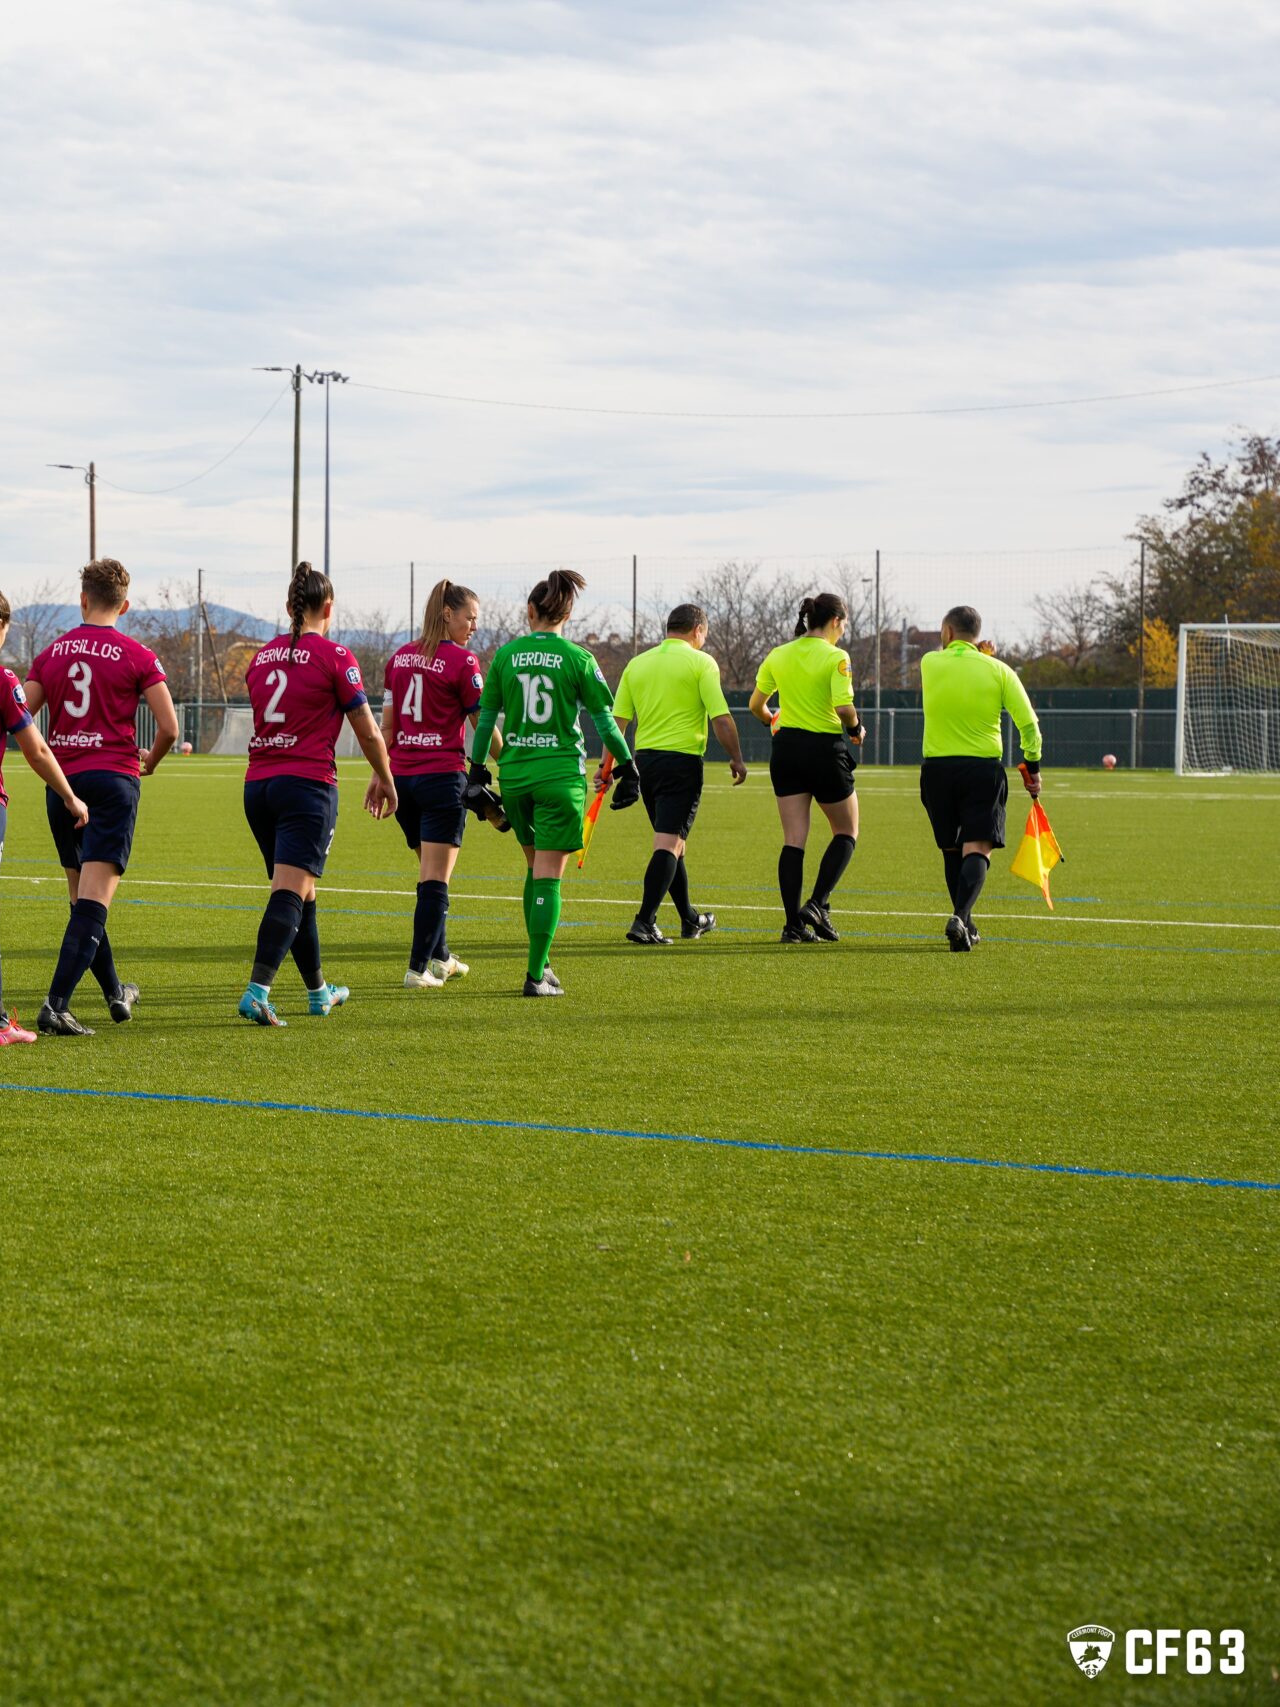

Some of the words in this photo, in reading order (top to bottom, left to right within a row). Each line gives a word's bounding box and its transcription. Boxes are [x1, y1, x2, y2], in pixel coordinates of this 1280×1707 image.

[51, 639, 122, 661] PITSILLOS
[255, 647, 310, 666] BERNARD
[511, 651, 563, 669] VERDIER
[64, 661, 92, 718] 3
[264, 669, 288, 723] 2
[401, 673, 423, 722] 4
[516, 673, 554, 724] 16
